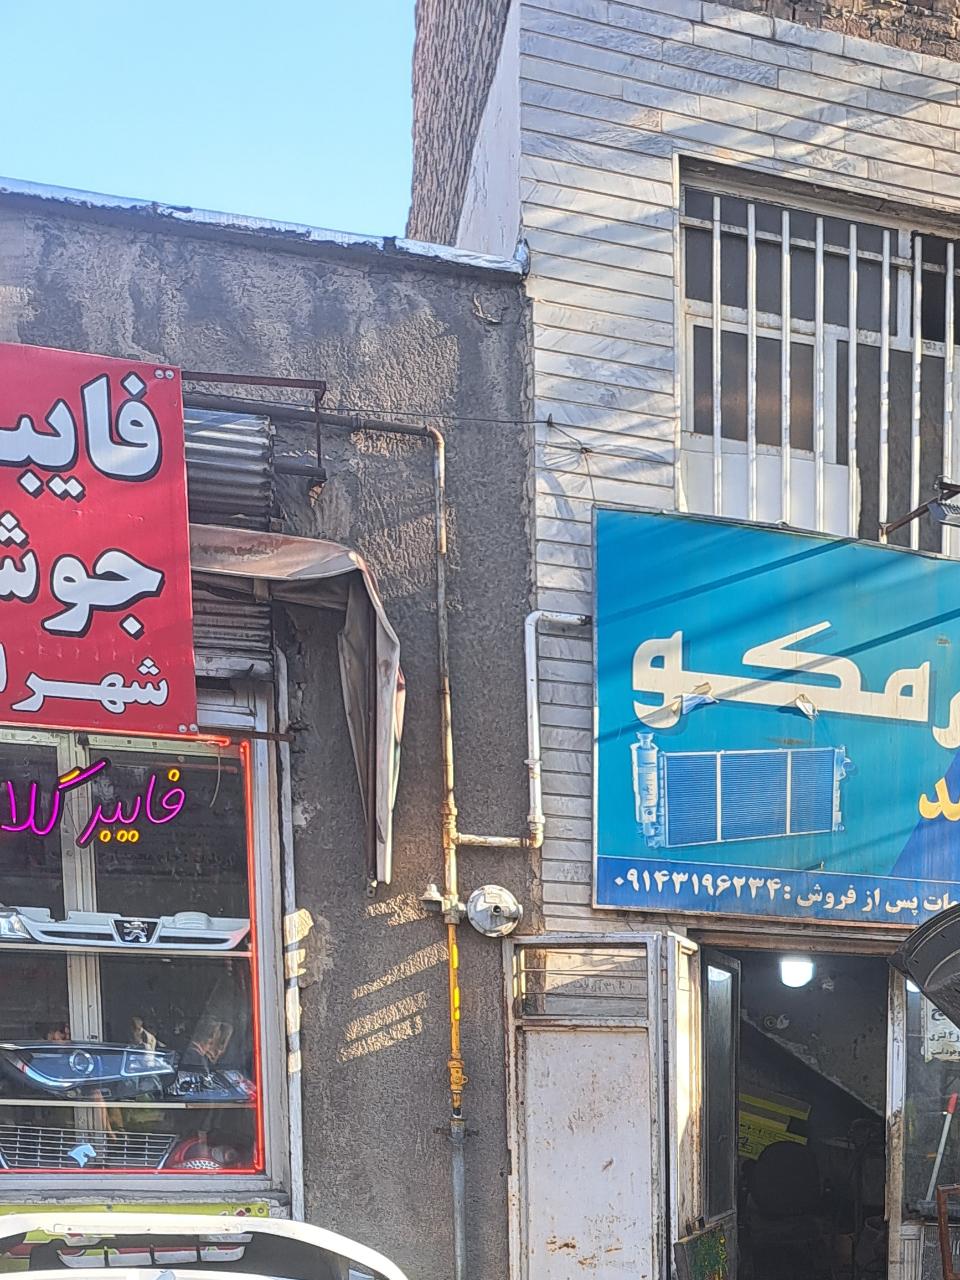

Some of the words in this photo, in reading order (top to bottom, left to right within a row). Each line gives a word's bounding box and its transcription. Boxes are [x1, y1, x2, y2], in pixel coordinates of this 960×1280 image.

[0, 372, 162, 499] فایب
[78, 768, 186, 845] فایبر
[796, 884, 858, 910] فروش
[861, 887, 880, 912] از
[885, 892, 919, 916] پس
